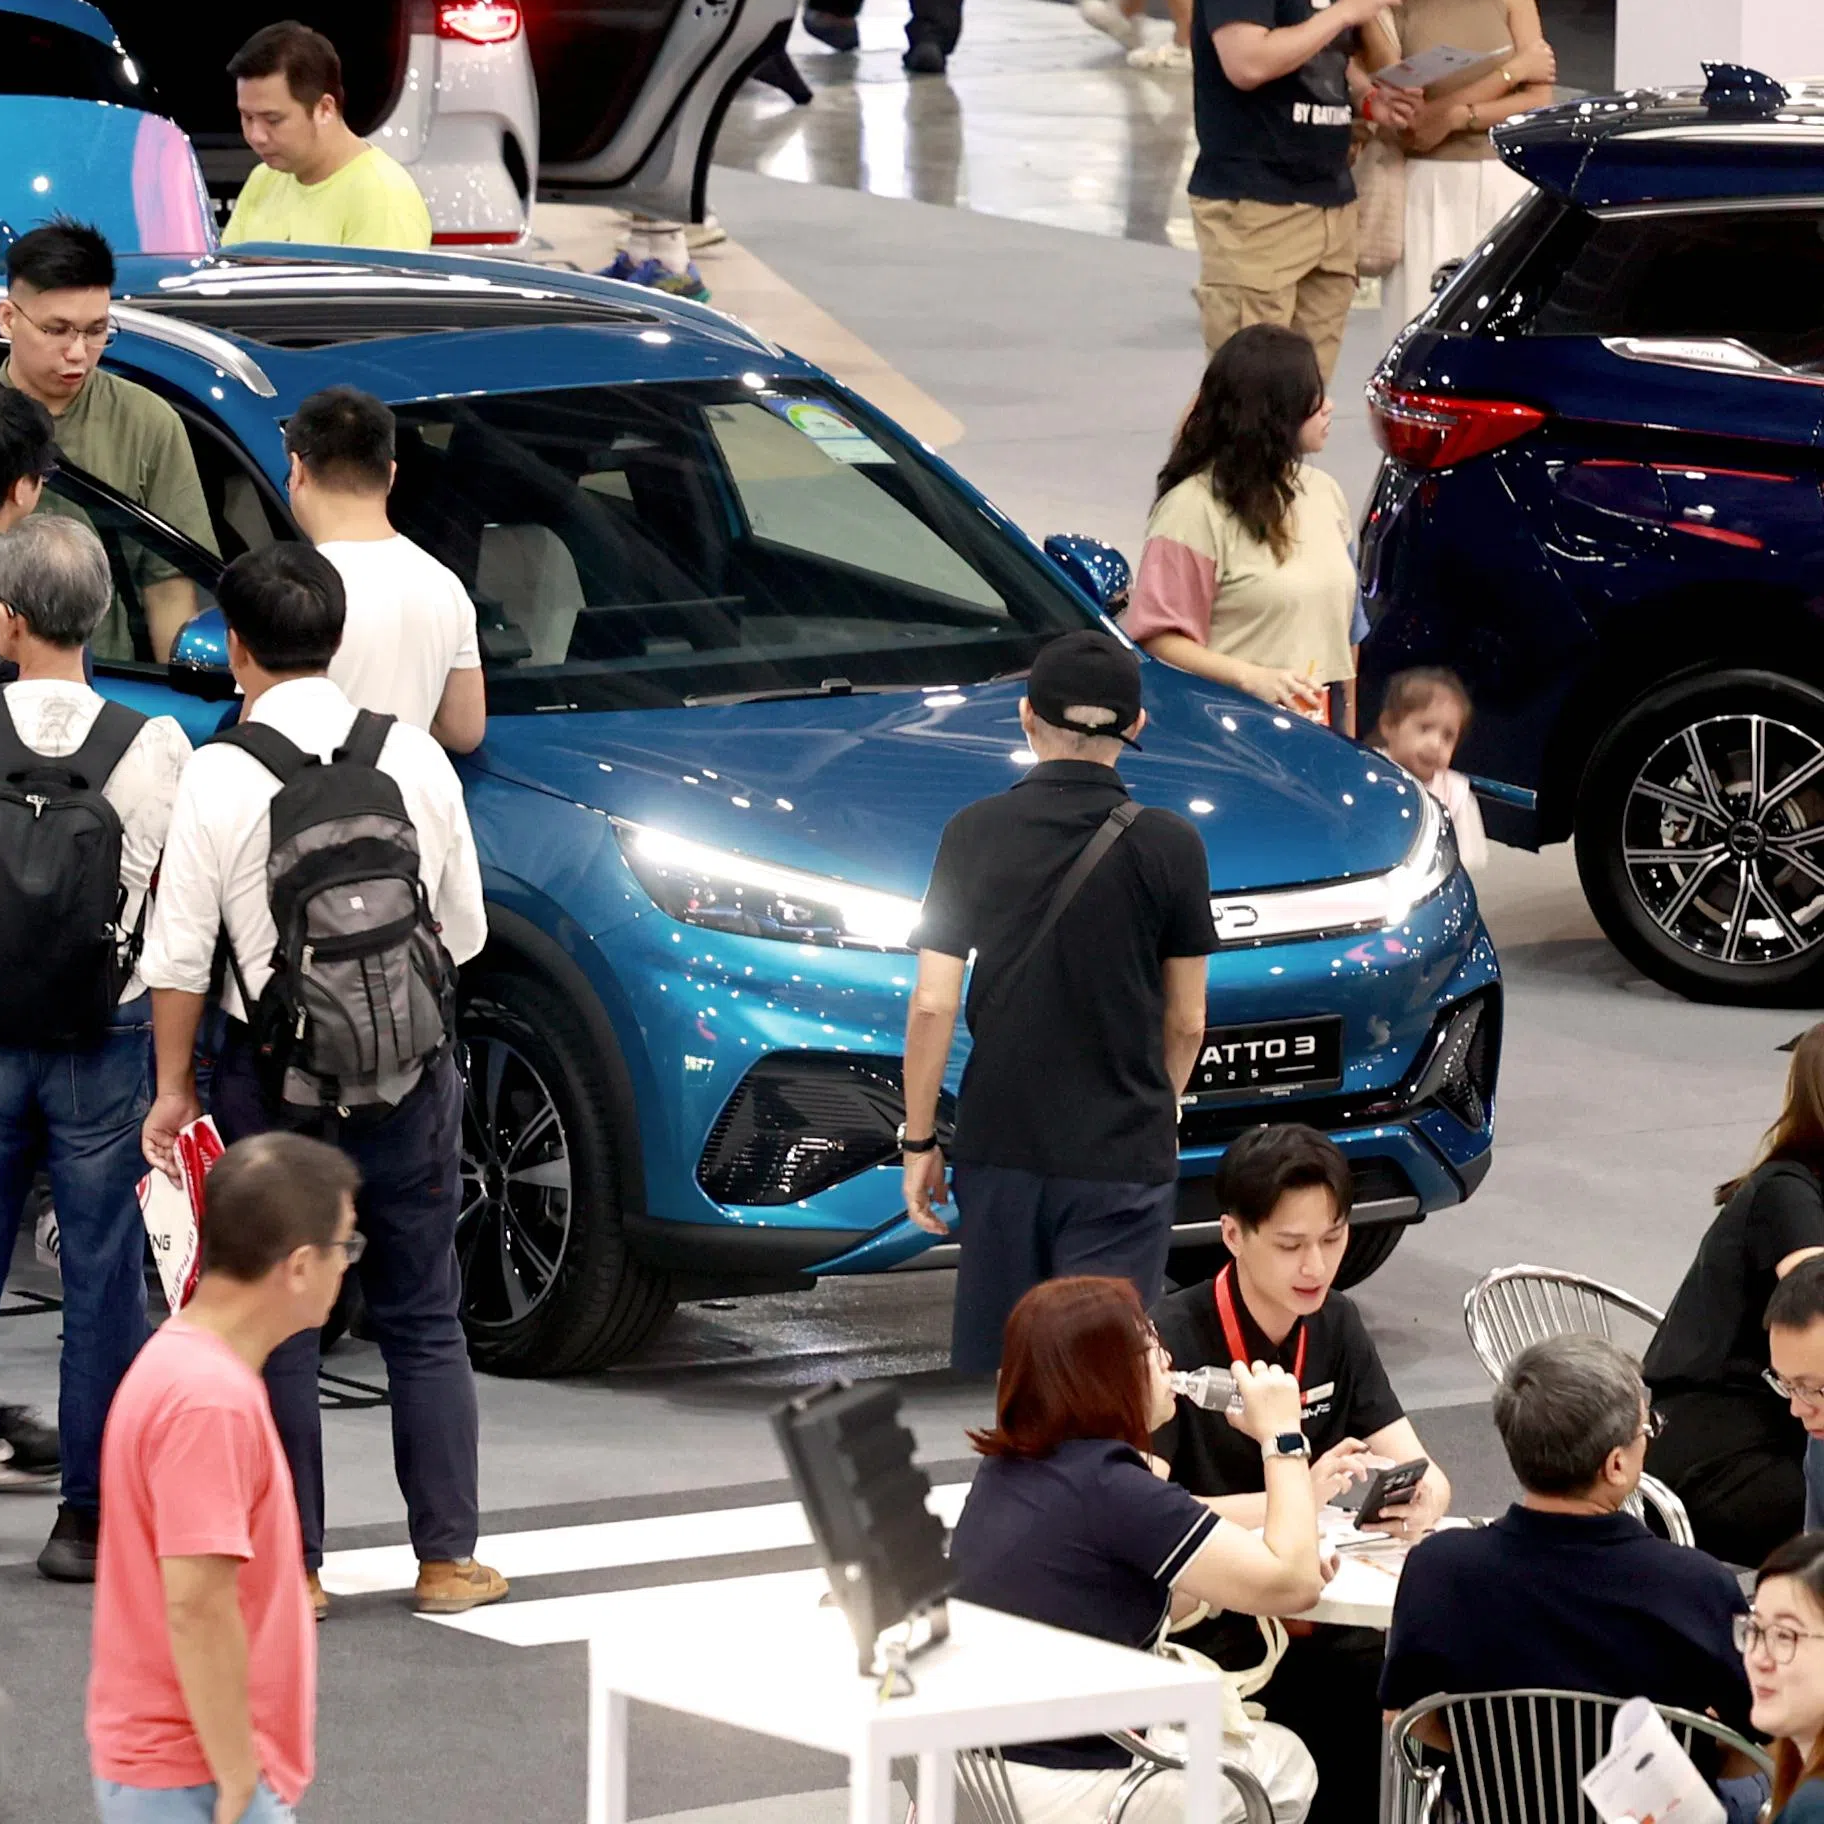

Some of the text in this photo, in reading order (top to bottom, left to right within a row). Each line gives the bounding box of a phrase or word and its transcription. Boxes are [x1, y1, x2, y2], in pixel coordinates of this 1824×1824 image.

[1293, 101, 1311, 125] BY
[1199, 1034, 1316, 1066] ATTO 3
